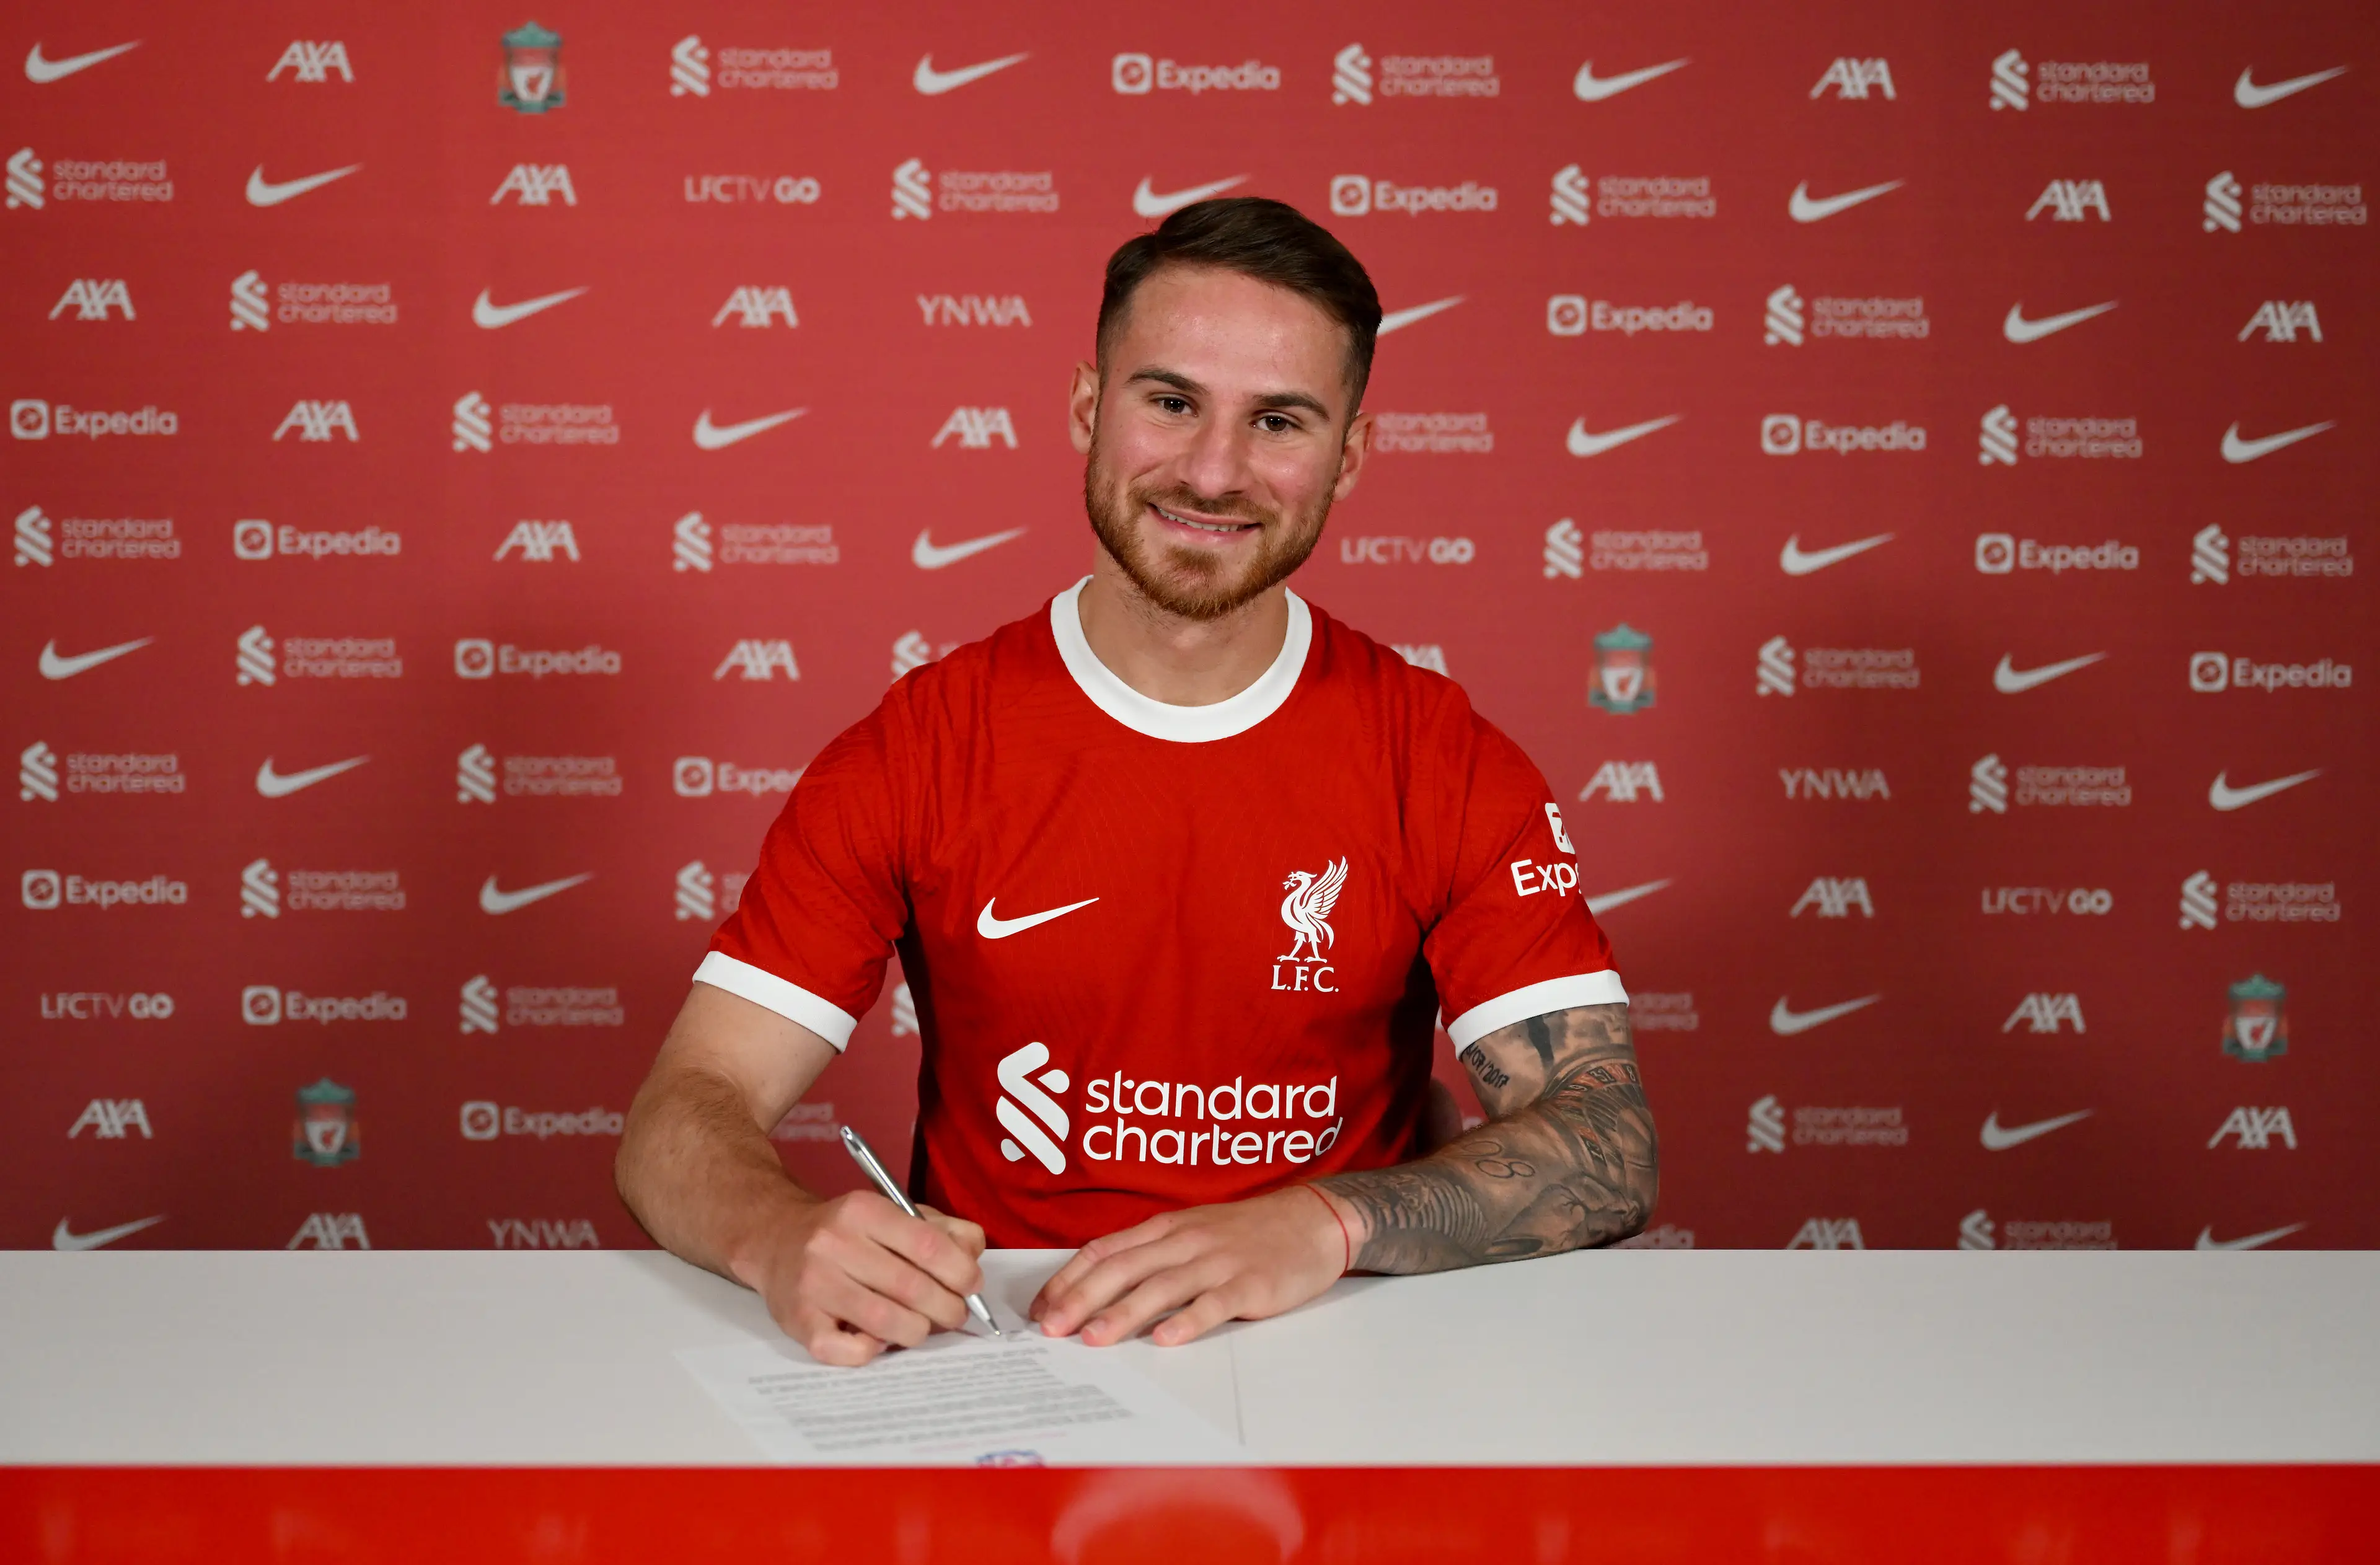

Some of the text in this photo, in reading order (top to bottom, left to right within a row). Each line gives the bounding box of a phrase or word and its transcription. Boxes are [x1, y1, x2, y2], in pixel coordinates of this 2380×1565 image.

[268, 42, 353, 81] AXA
[720, 48, 832, 68] standard
[1382, 56, 1494, 76] standard
[719, 69, 838, 89] chartered
[1156, 60, 1279, 94] Expedia
[1811, 59, 1895, 99] AXA
[2039, 62, 2149, 82] standard
[1381, 77, 1499, 96] chartered
[2038, 83, 2154, 102] chartered
[55, 161, 167, 180] standard
[55, 181, 173, 200] chartered
[491, 165, 576, 205] AXA
[940, 172, 1053, 191] standard
[1599, 177, 1710, 196] standard
[940, 192, 1059, 211] chartered
[1374, 182, 1496, 215] Expedia
[2027, 181, 2110, 220] AXA
[2253, 184, 2361, 204] standard
[1598, 198, 1716, 217] chartered
[2251, 205, 2366, 224] chartered
[50, 280, 134, 319] AXA
[279, 283, 392, 302] standard
[279, 304, 397, 323] chartered
[713, 287, 798, 327] AXA
[918, 296, 1031, 325] YNWA
[1814, 298, 1923, 317] standard
[1591, 302, 1712, 335] Expedia
[1812, 318, 1929, 338] chartered
[2239, 302, 2322, 341] AXA
[57, 407, 177, 439] Expedia
[274, 402, 358, 440] AXA
[501, 405, 614, 423] standard
[1376, 413, 1486, 432] standard
[501, 425, 619, 444] chartered
[933, 408, 1017, 447] AXA
[2028, 417, 2136, 437] standard
[1375, 433, 1493, 452] chartered
[1807, 421, 1925, 454] Expedia
[2027, 438, 2142, 457] chartered
[63, 519, 175, 537] standard
[721, 525, 833, 544] standard
[63, 539, 180, 558] chartered
[280, 526, 400, 558] Expedia
[495, 521, 579, 560] AXA
[1592, 531, 1703, 550] standard
[2240, 537, 2347, 556] standard
[721, 545, 839, 563] chartered
[1591, 551, 1708, 570] chartered
[2021, 540, 2138, 573] Expedia
[2239, 557, 2353, 576] chartered
[284, 638, 396, 657] standard
[284, 658, 402, 677] chartered
[501, 646, 619, 676] Expedia
[715, 641, 799, 679] AXA
[1806, 650, 1913, 668] standard
[1805, 669, 1919, 687] chartered
[2235, 659, 2351, 691] Expedia
[68, 754, 179, 773] standard
[506, 758, 616, 775] standard
[68, 774, 185, 792] chartered
[506, 776, 622, 795] chartered
[1579, 762, 1663, 801] AXA
[1781, 770, 1889, 798] YNWA
[2017, 767, 2125, 785] standard
[2017, 787, 2131, 805] chartered
[289, 871, 399, 889] standard
[1510, 859, 1582, 897] Exp
[68, 876, 186, 908] Expedia
[289, 891, 405, 909] chartered
[1791, 878, 1872, 916] AXA
[2228, 883, 2335, 901] standard
[2226, 902, 2340, 920] chartered
[1271, 965, 1339, 992] L.F.C.
[508, 989, 617, 1005] standard
[288, 992, 405, 1023] Expedia
[508, 1007, 623, 1025] chartered
[2004, 994, 2084, 1032] AXA
[1086, 1070, 1337, 1121] standard
[69, 1100, 151, 1137] AXA
[506, 1108, 620, 1137] Expedia
[1795, 1108, 1902, 1125] standard
[1794, 1126, 1907, 1144] chartered
[2209, 1108, 2296, 1148] AXA
[1083, 1116, 1343, 1166] chartered
[286, 1213, 370, 1250] AXA
[487, 1219, 600, 1250] YNWA
[1786, 1217, 1864, 1250] AXA
[2006, 1221, 2110, 1240] standard
